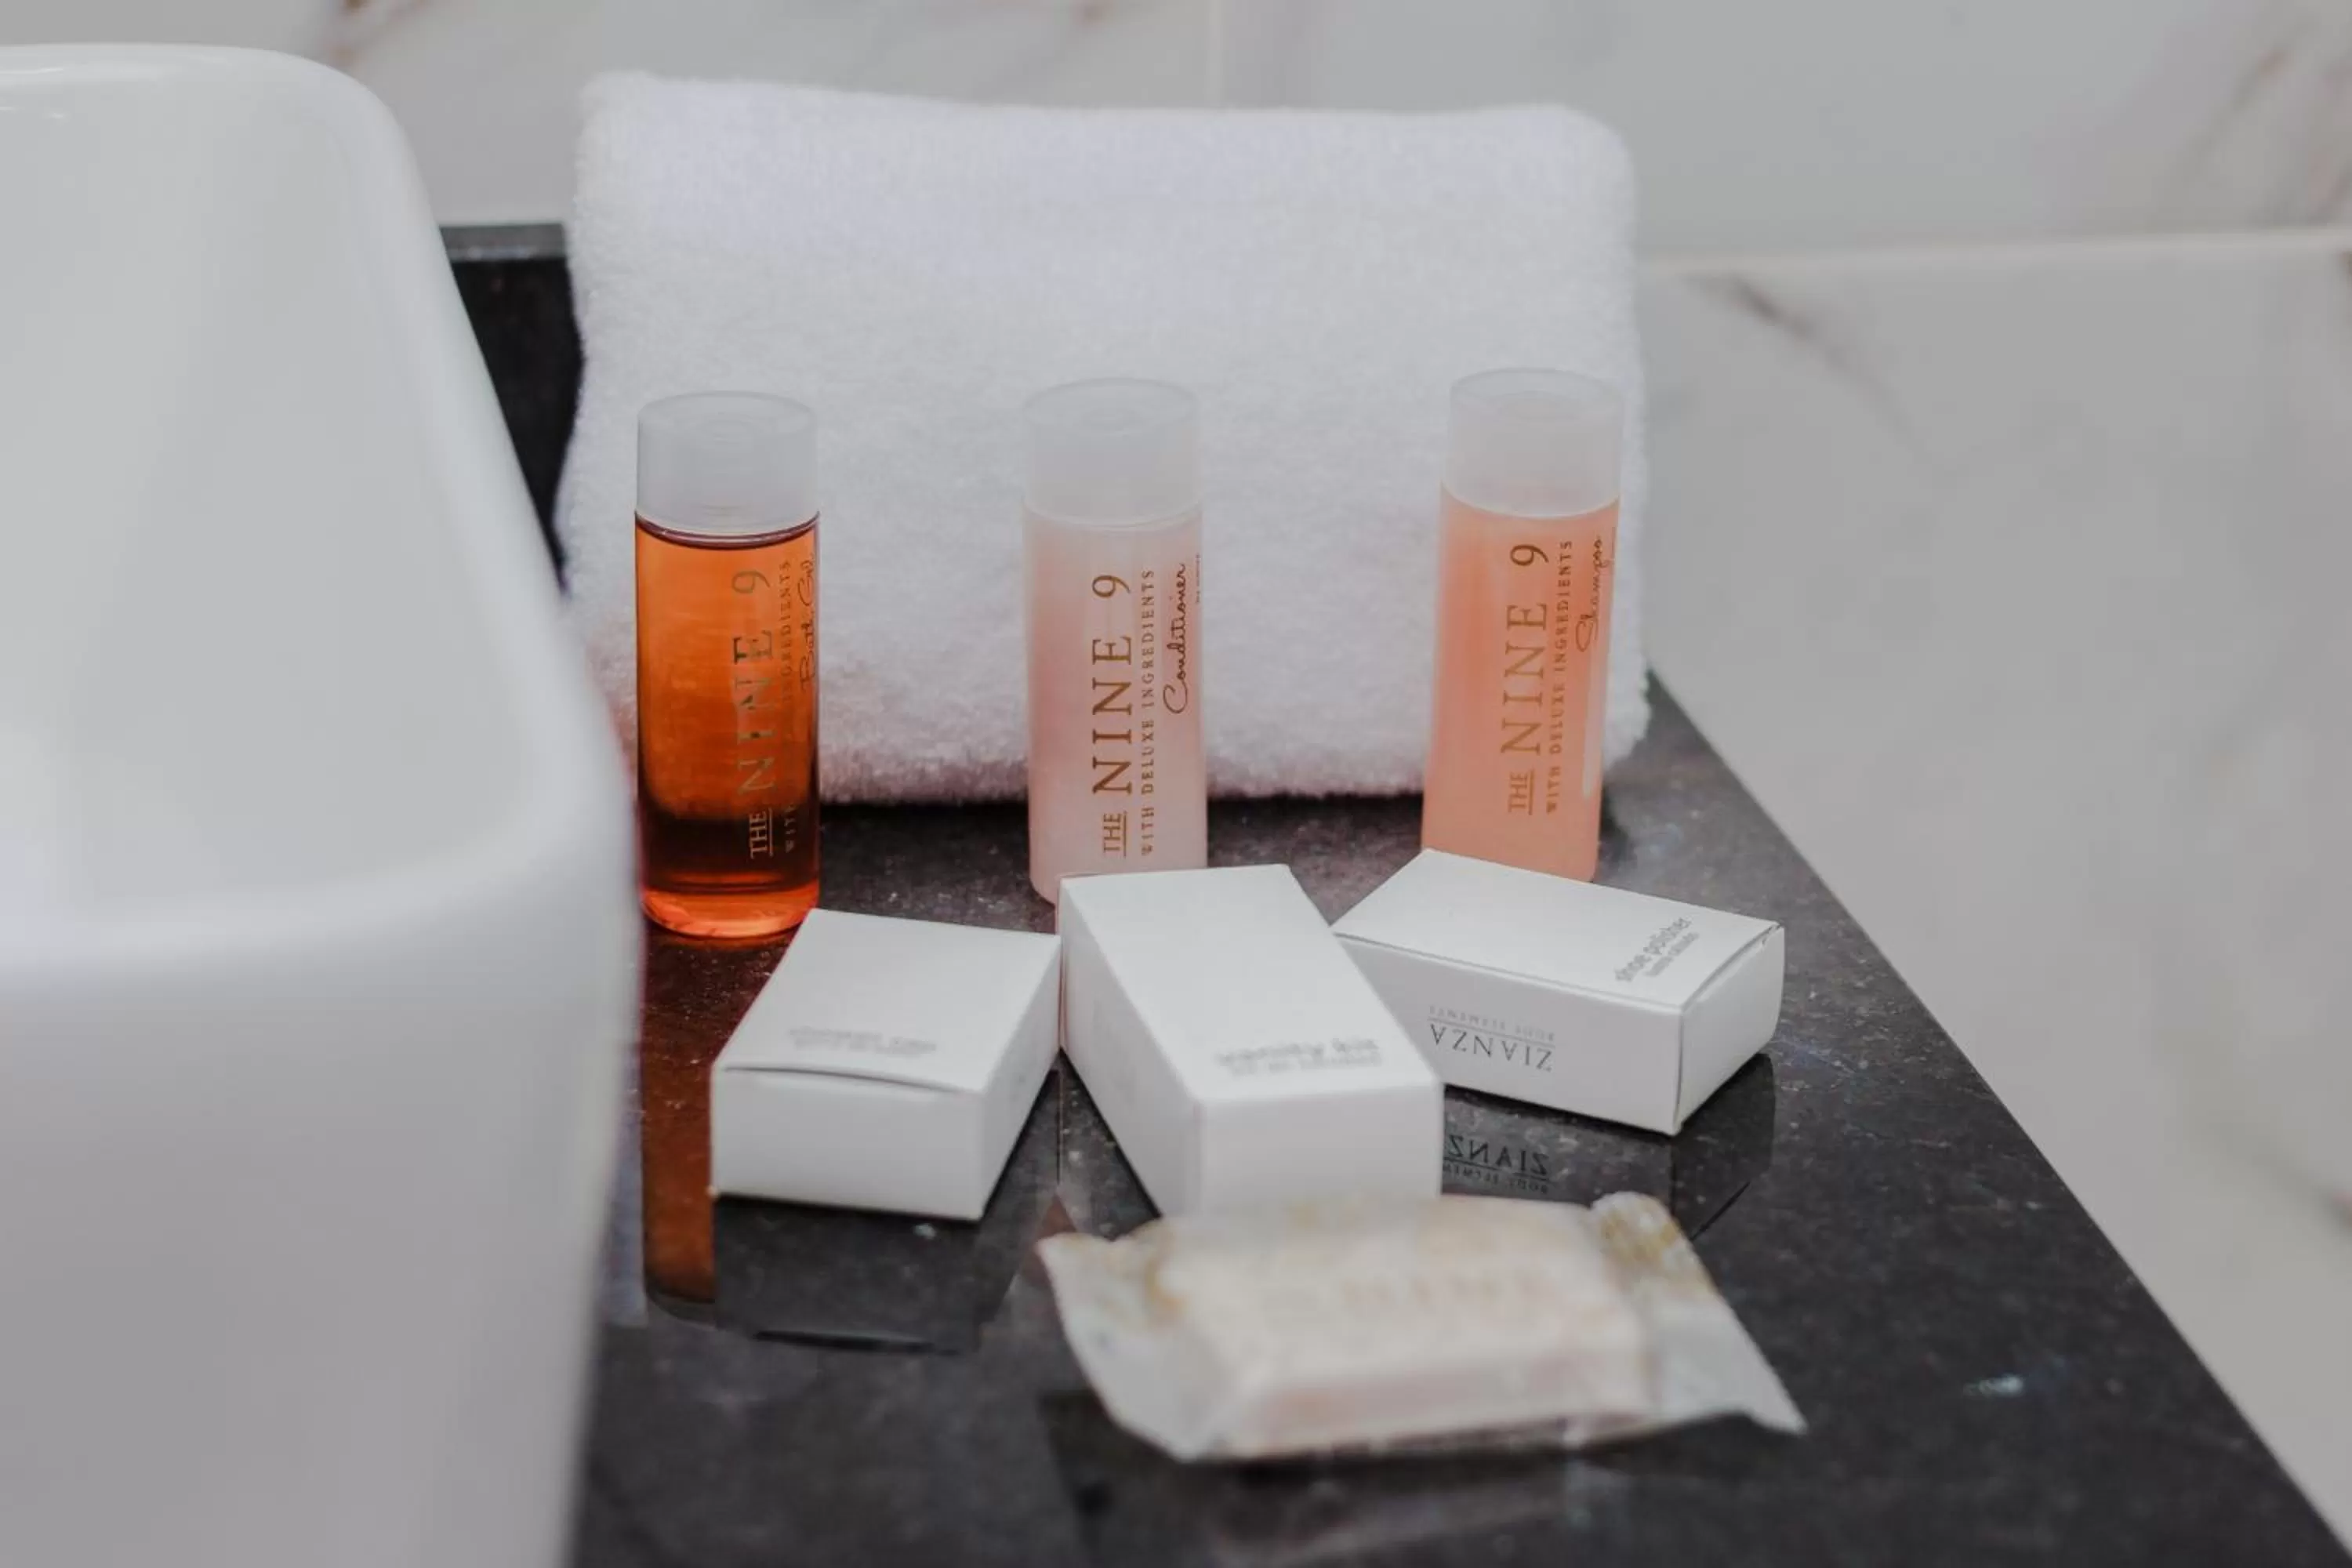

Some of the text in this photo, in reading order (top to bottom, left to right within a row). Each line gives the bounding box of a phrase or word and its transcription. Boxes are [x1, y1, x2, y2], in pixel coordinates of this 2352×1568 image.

[731, 570, 775, 858] THE NINE 9
[1091, 574, 1131, 854] THE NINE 9
[1142, 570, 1155, 856] WITH DELUXE INGREDIENTS
[1163, 563, 1188, 714] Conditioner
[1501, 543, 1550, 814] THE NINE 9
[1546, 540, 1573, 815] WITH DELUXE INGREDIENTS
[1575, 538, 1607, 653] Shampoo
[1429, 1023, 1553, 1073] ZIANZA
